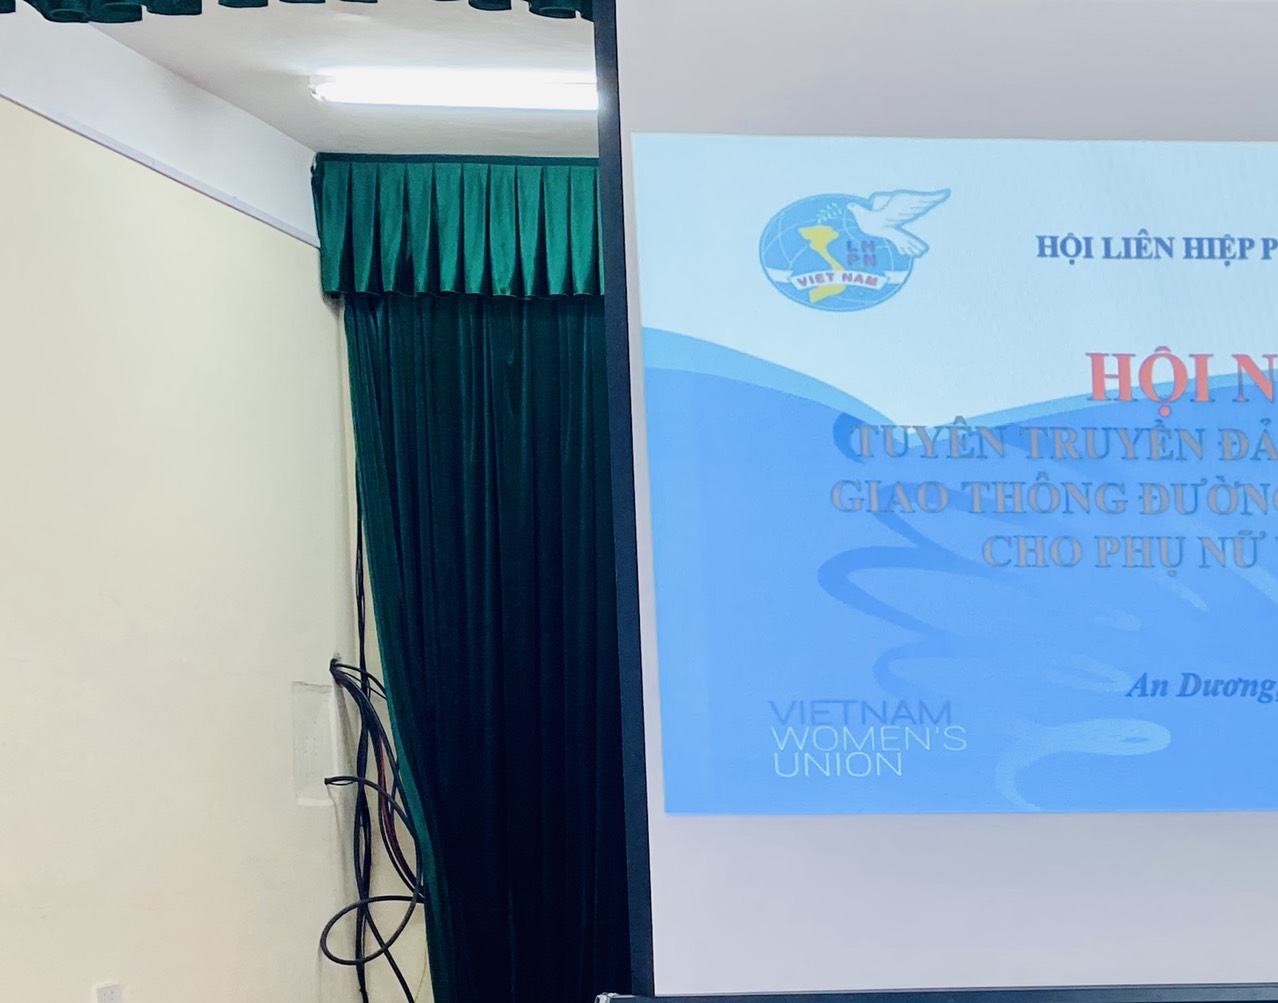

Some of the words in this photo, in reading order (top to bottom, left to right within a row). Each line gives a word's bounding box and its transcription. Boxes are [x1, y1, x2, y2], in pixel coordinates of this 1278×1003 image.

[1036, 232, 1094, 266] HỘI
[1102, 228, 1175, 260] LIÊN
[1182, 234, 1256, 267] HIỆP
[842, 272, 878, 286] NAM
[1085, 346, 1215, 418] HỘI
[850, 415, 1007, 460] TUYÊN
[1019, 418, 1204, 461] TRUYỀN
[831, 479, 949, 514] GIAO
[961, 471, 1129, 515] THÔNG
[982, 535, 1083, 569] CHO
[1094, 535, 1184, 577] PHỤ
[1198, 529, 1267, 569] NỮ
[1124, 672, 1169, 697] An
[769, 700, 952, 726] VIETNAM
[771, 726, 967, 751] WOMEN'S
[773, 752, 902, 777] UNION
